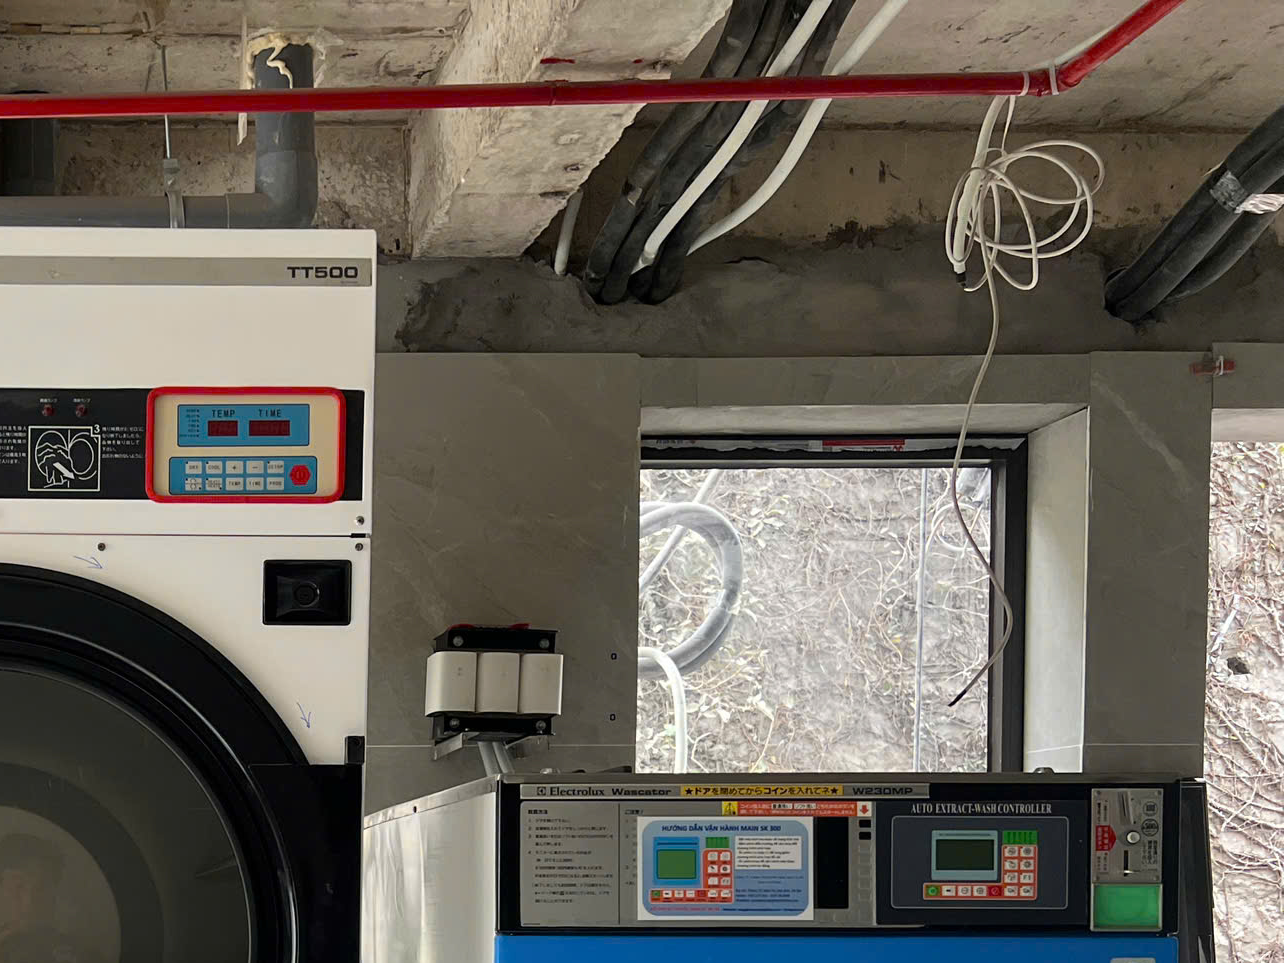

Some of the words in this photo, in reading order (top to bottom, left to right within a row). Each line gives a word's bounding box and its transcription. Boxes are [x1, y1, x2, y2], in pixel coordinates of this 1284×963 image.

[287, 266, 358, 278] TT500
[212, 409, 236, 417] TEMP
[258, 408, 282, 417] TIME
[94, 424, 100, 433] 3
[549, 787, 605, 796] Electrolux
[611, 788, 672, 796] Wascator
[852, 787, 913, 795] W230MP
[911, 803, 933, 813] AUTO
[935, 803, 997, 813] EXTRACT-WASH
[997, 803, 1052, 814] CONTROLLER
[662, 824, 687, 832] HƯỚNG
[704, 824, 718, 833] VẬN
[720, 824, 739, 832] HÀNH
